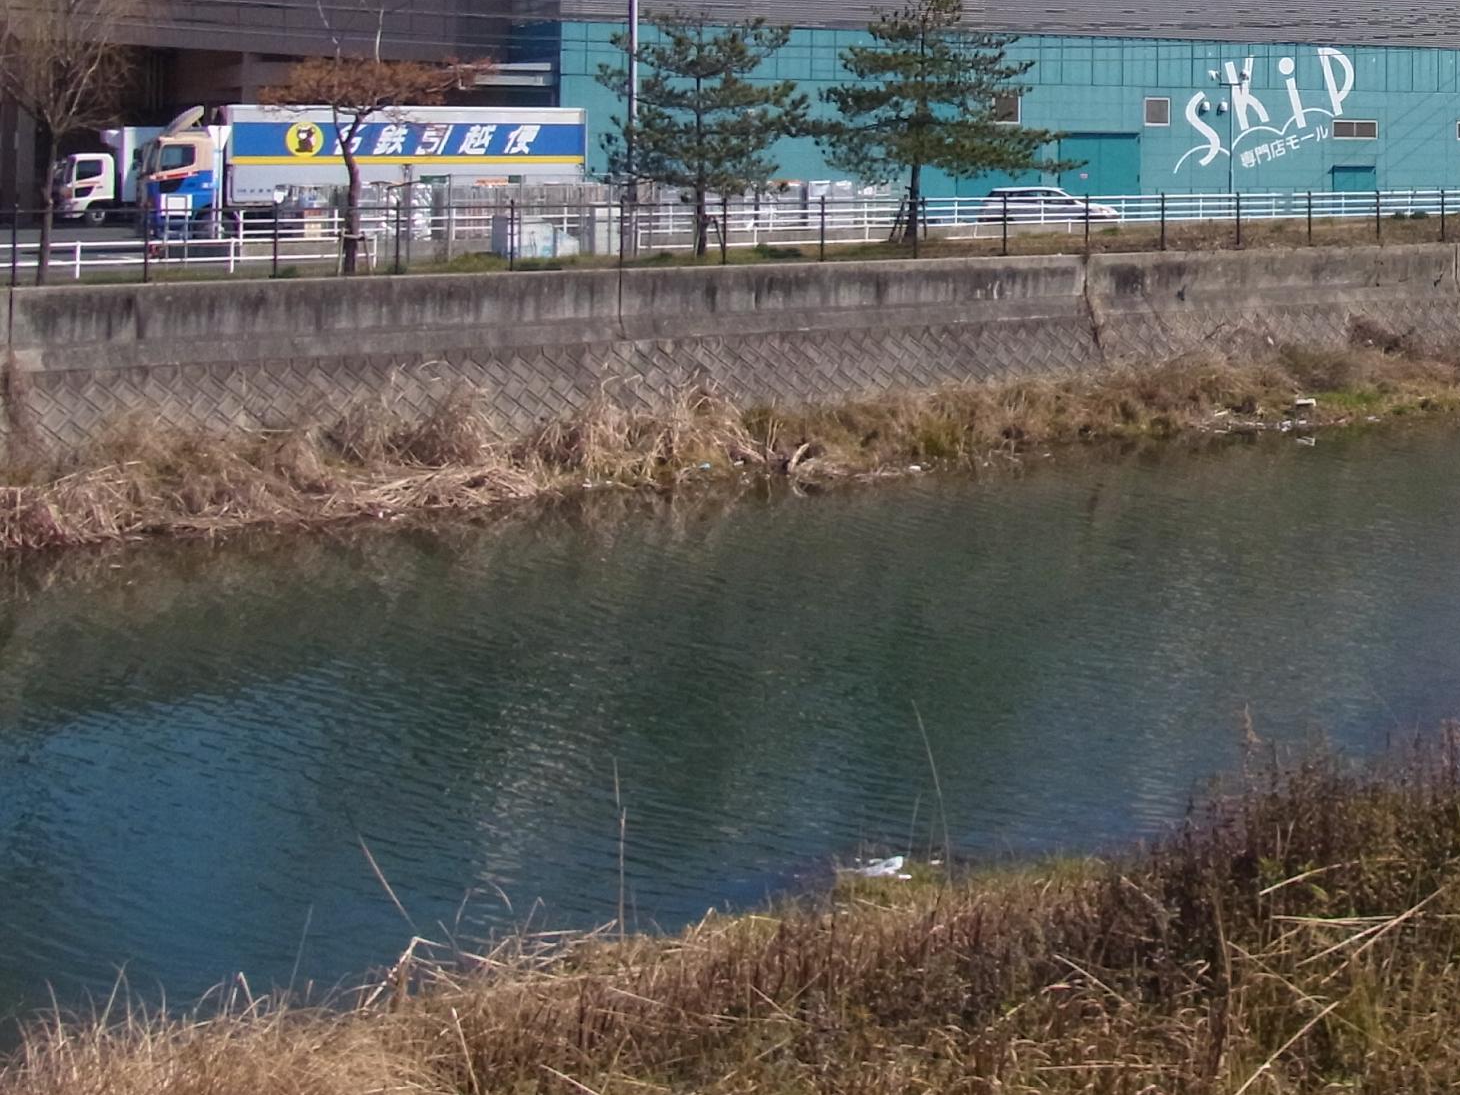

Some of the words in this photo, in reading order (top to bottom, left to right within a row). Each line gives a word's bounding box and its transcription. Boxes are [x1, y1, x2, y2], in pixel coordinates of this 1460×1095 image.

[1240, 124, 1329, 169] 専門店モール
